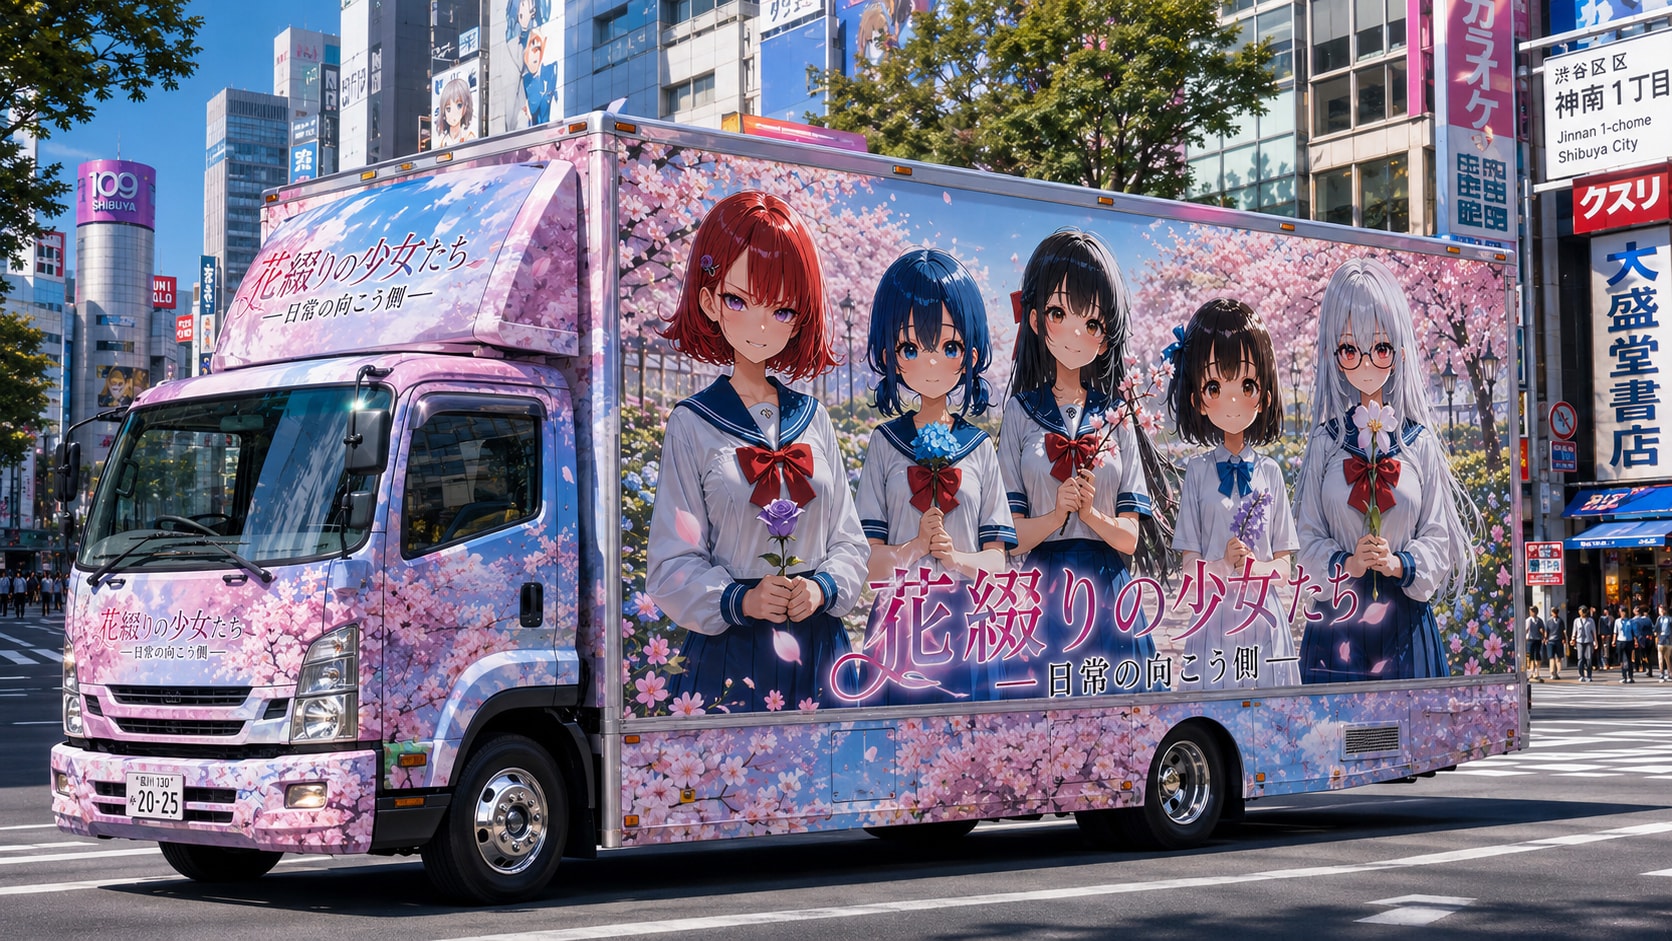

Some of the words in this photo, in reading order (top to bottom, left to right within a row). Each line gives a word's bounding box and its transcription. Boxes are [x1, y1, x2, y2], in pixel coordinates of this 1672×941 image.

[1463, 0, 1498, 129] カラオケ
[1555, 69, 1669, 119] 神南1丁目
[1557, 127, 1597, 144] Jinnan
[1600, 116, 1652, 135] 1-chome
[1558, 145, 1608, 164] Shibuya
[1612, 138, 1638, 153] City
[89, 171, 138, 199] 109
[1580, 176, 1660, 220] クスリ
[93, 200, 136, 212] SHIBUYA
[236, 232, 468, 315] 花綴りの少女たち
[1607, 241, 1661, 467] 大盛堂書店
[93, 607, 242, 648] 花綴りの少女たち
[831, 557, 1359, 701] 花綴りの少女たち
[138, 789, 178, 815] 20-25
[156, 777, 170, 788] 130
